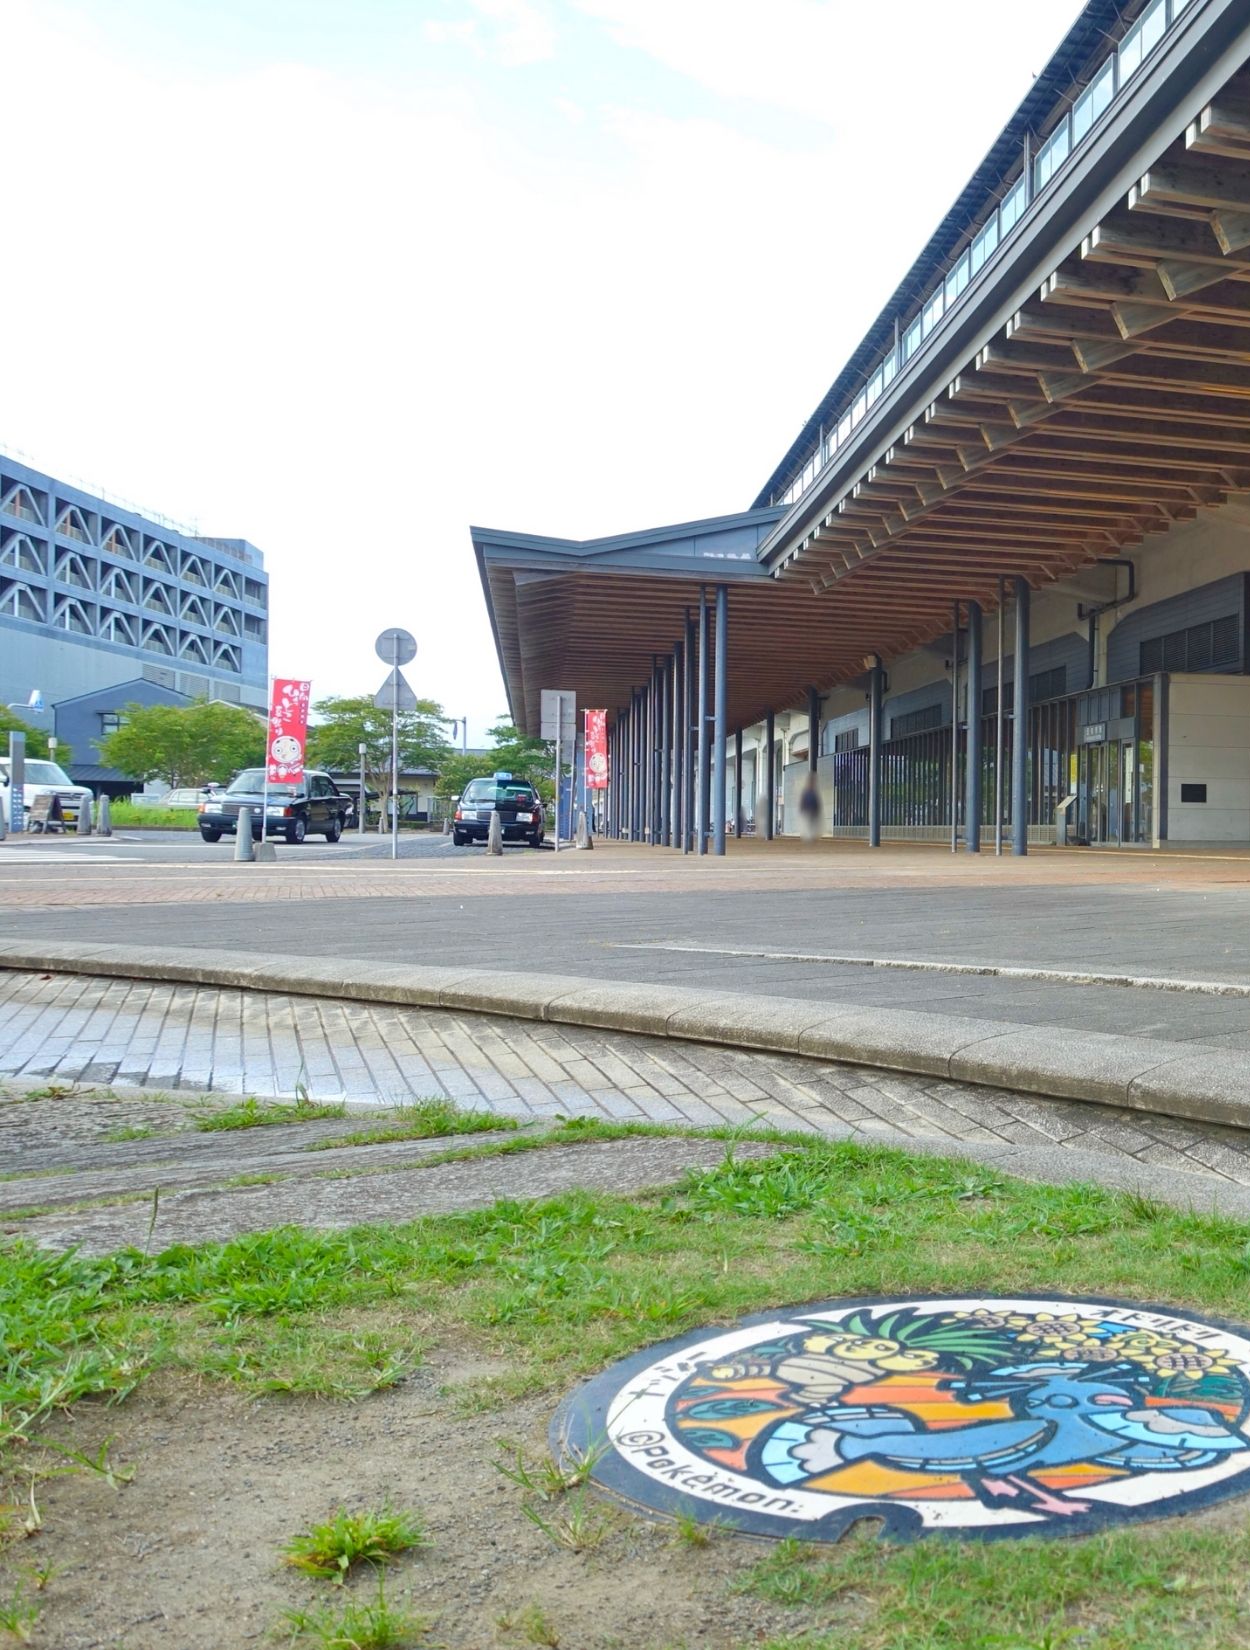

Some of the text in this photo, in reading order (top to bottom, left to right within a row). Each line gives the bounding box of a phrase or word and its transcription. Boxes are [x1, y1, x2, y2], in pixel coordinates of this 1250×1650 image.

[1091, 1309, 1223, 1341] オドリドリ
